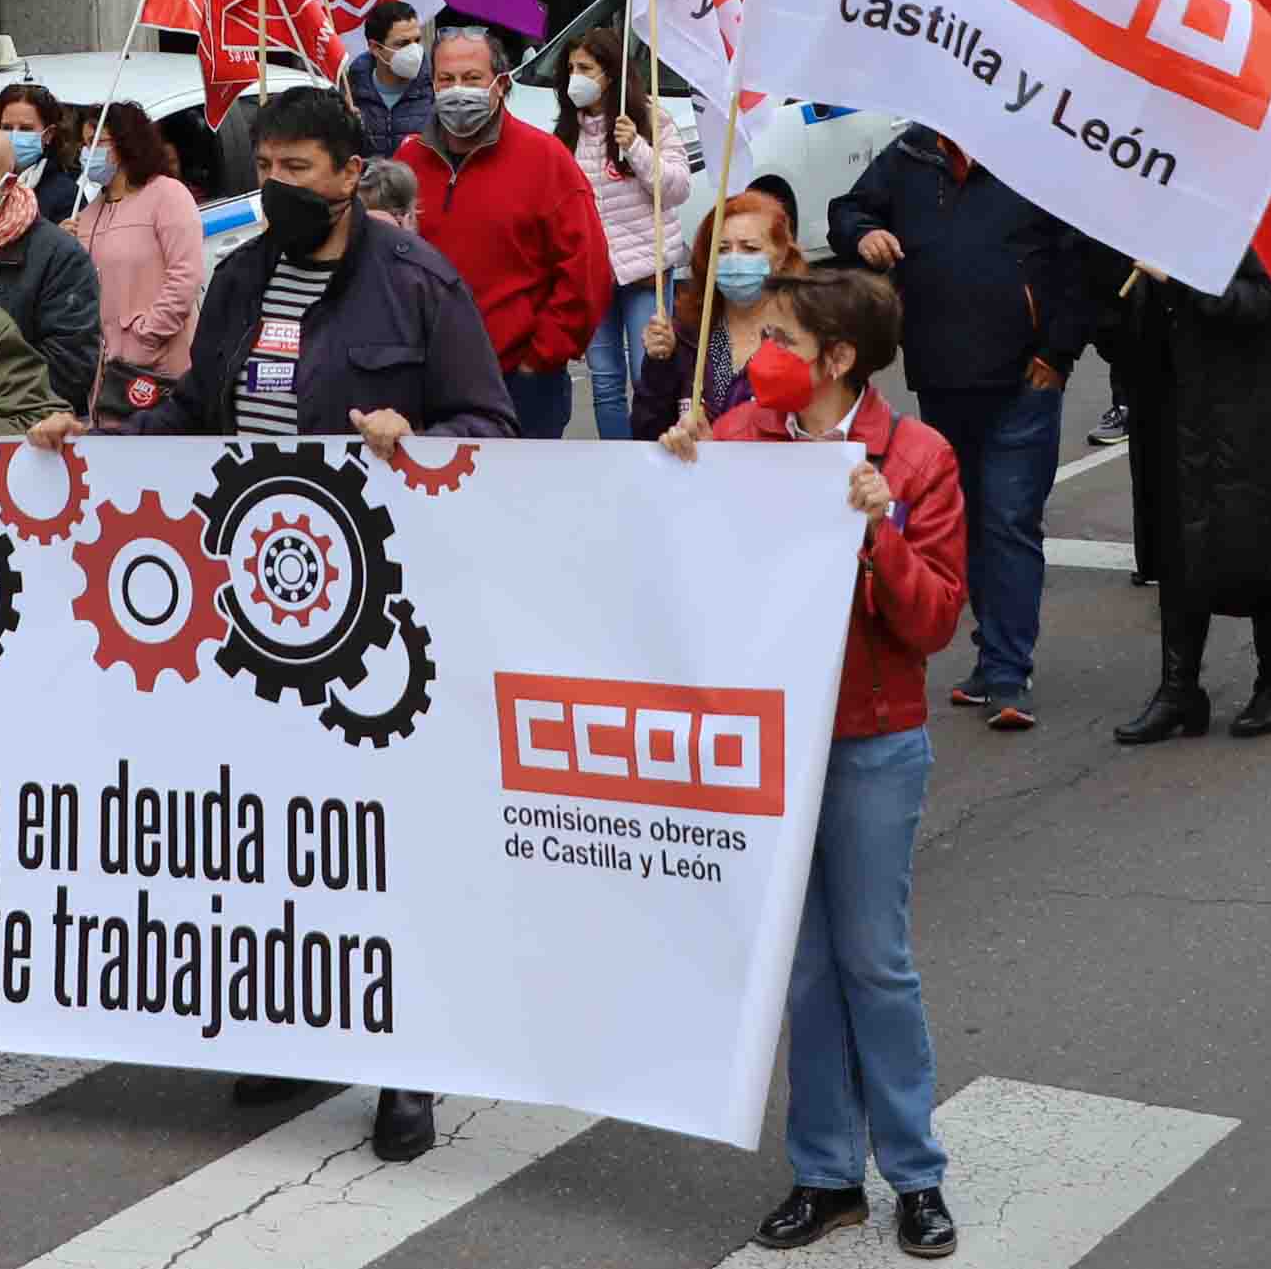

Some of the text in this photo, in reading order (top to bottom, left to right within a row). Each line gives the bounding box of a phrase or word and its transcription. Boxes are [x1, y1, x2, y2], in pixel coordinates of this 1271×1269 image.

[1005, 73, 1044, 112] y
[1053, 89, 1176, 186] León
[514, 700, 762, 786] CCOO
[19, 783, 78, 871] en
[101, 760, 264, 883] deuda
[288, 797, 385, 892] con
[503, 807, 746, 851] comisiones obreras
[505, 834, 721, 882] de Castilla y León
[53, 886, 393, 1038] trabajadora
